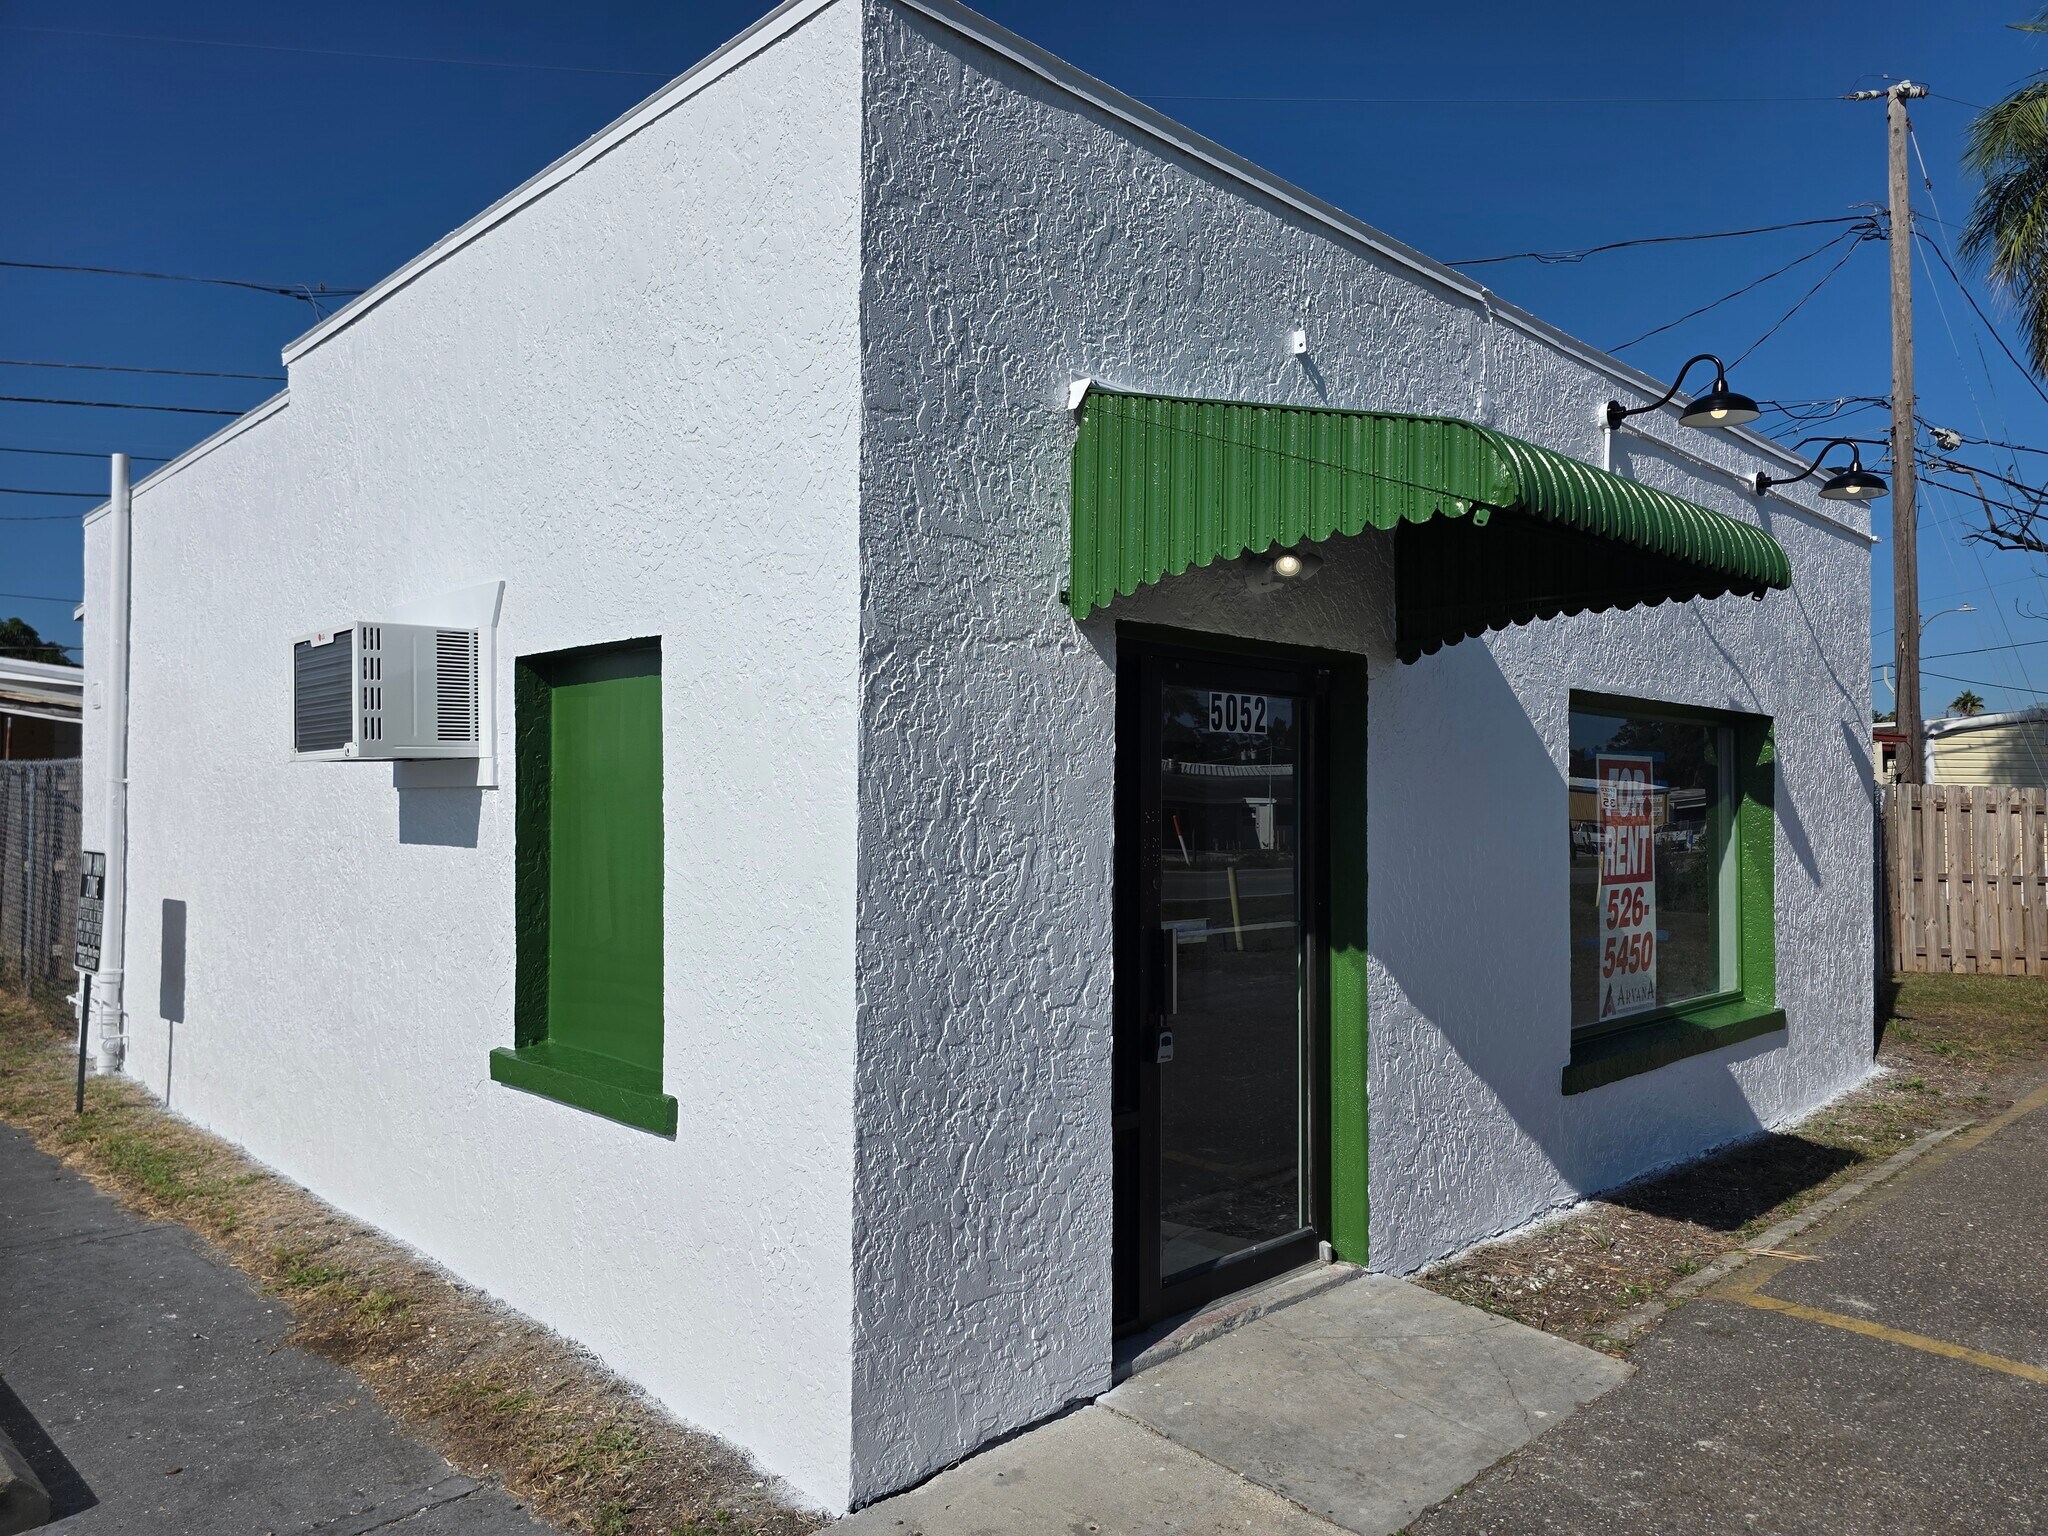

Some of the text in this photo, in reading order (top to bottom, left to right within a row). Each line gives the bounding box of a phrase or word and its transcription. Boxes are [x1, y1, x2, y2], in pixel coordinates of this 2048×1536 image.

[1210, 693, 1266, 733] 5052
[1605, 767, 1645, 818] FOR
[1603, 825, 1650, 876] RENT
[1606, 886, 1650, 930] 526-
[1602, 931, 1653, 979] 5450
